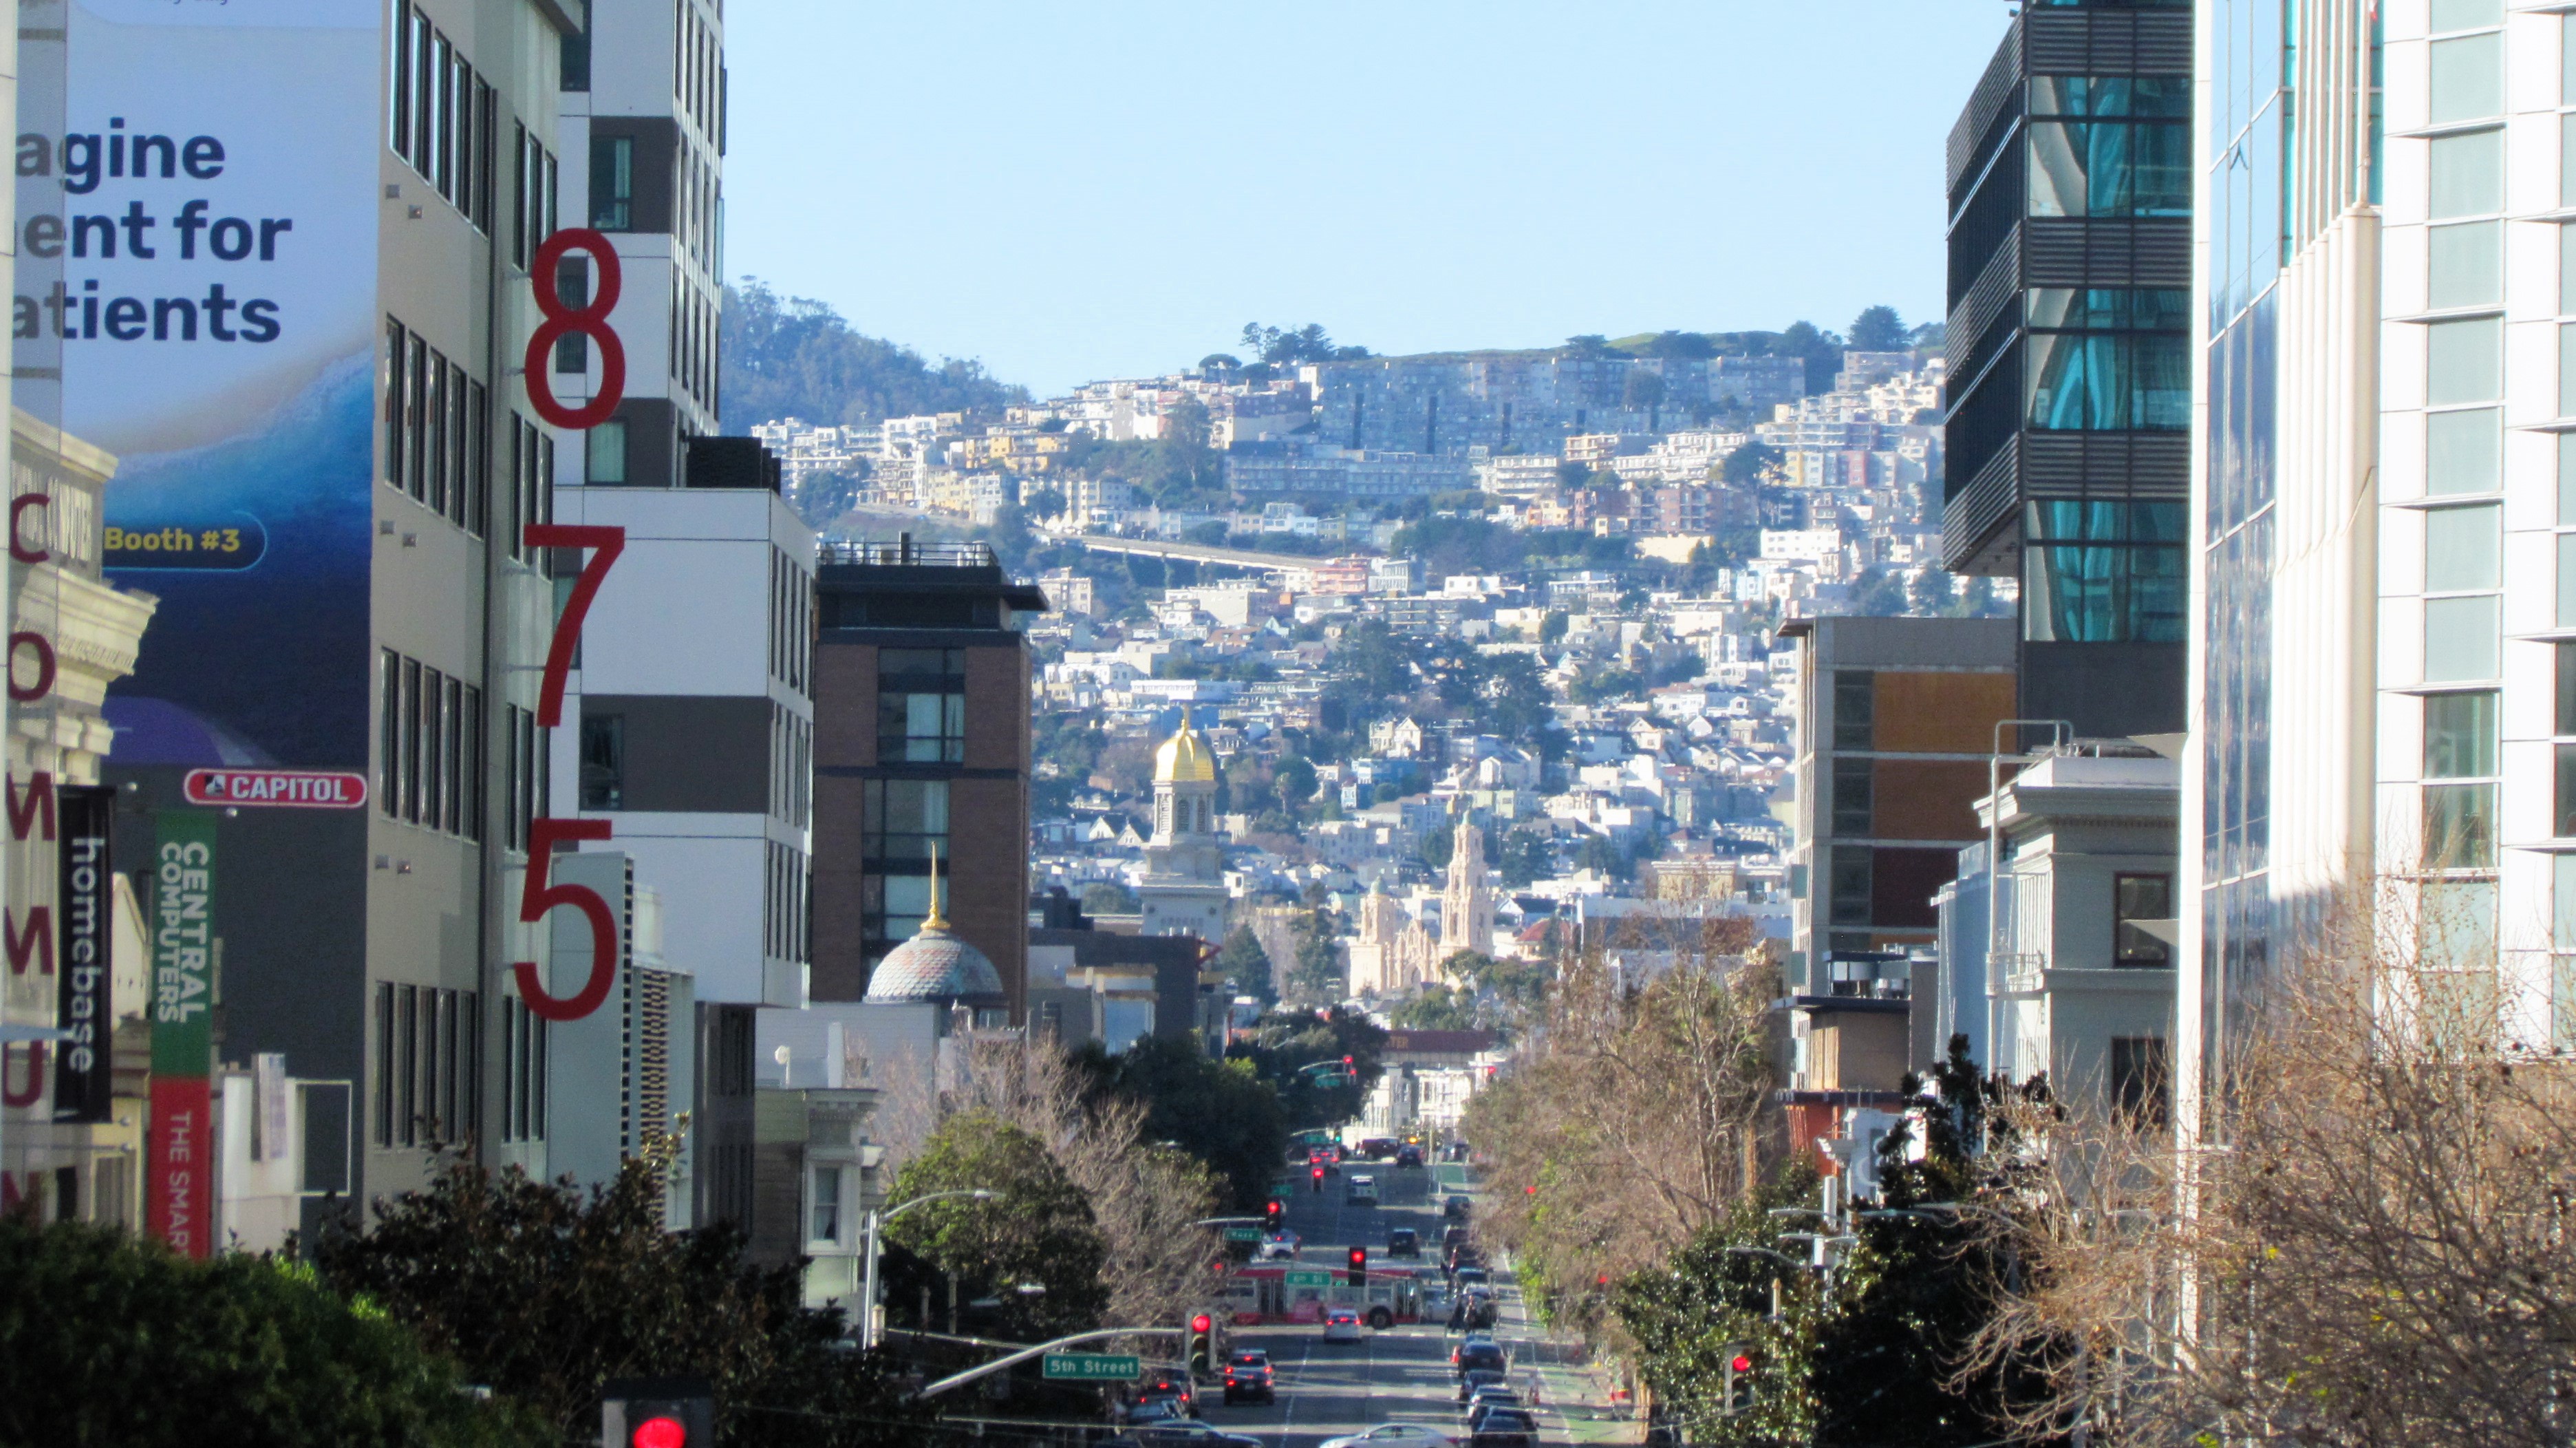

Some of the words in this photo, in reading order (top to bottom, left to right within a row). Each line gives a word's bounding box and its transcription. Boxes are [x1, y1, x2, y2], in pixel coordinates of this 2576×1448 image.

[16, 117, 225, 195] agine
[14, 201, 155, 259] ent
[173, 199, 292, 261] for
[12, 279, 281, 343] atients
[104, 527, 193, 551] Booth
[200, 529, 240, 552] #3
[515, 228, 625, 1022] 875
[231, 776, 349, 802] CAPITOL
[69, 838, 105, 1074] homebase
[157, 842, 182, 1023] COMPUTERS
[180, 841, 209, 1023] CENTRAL
[170, 1110, 192, 1163] THE
[1051, 1359, 1076, 1373] 5th
[1084, 1359, 1134, 1374] Street
